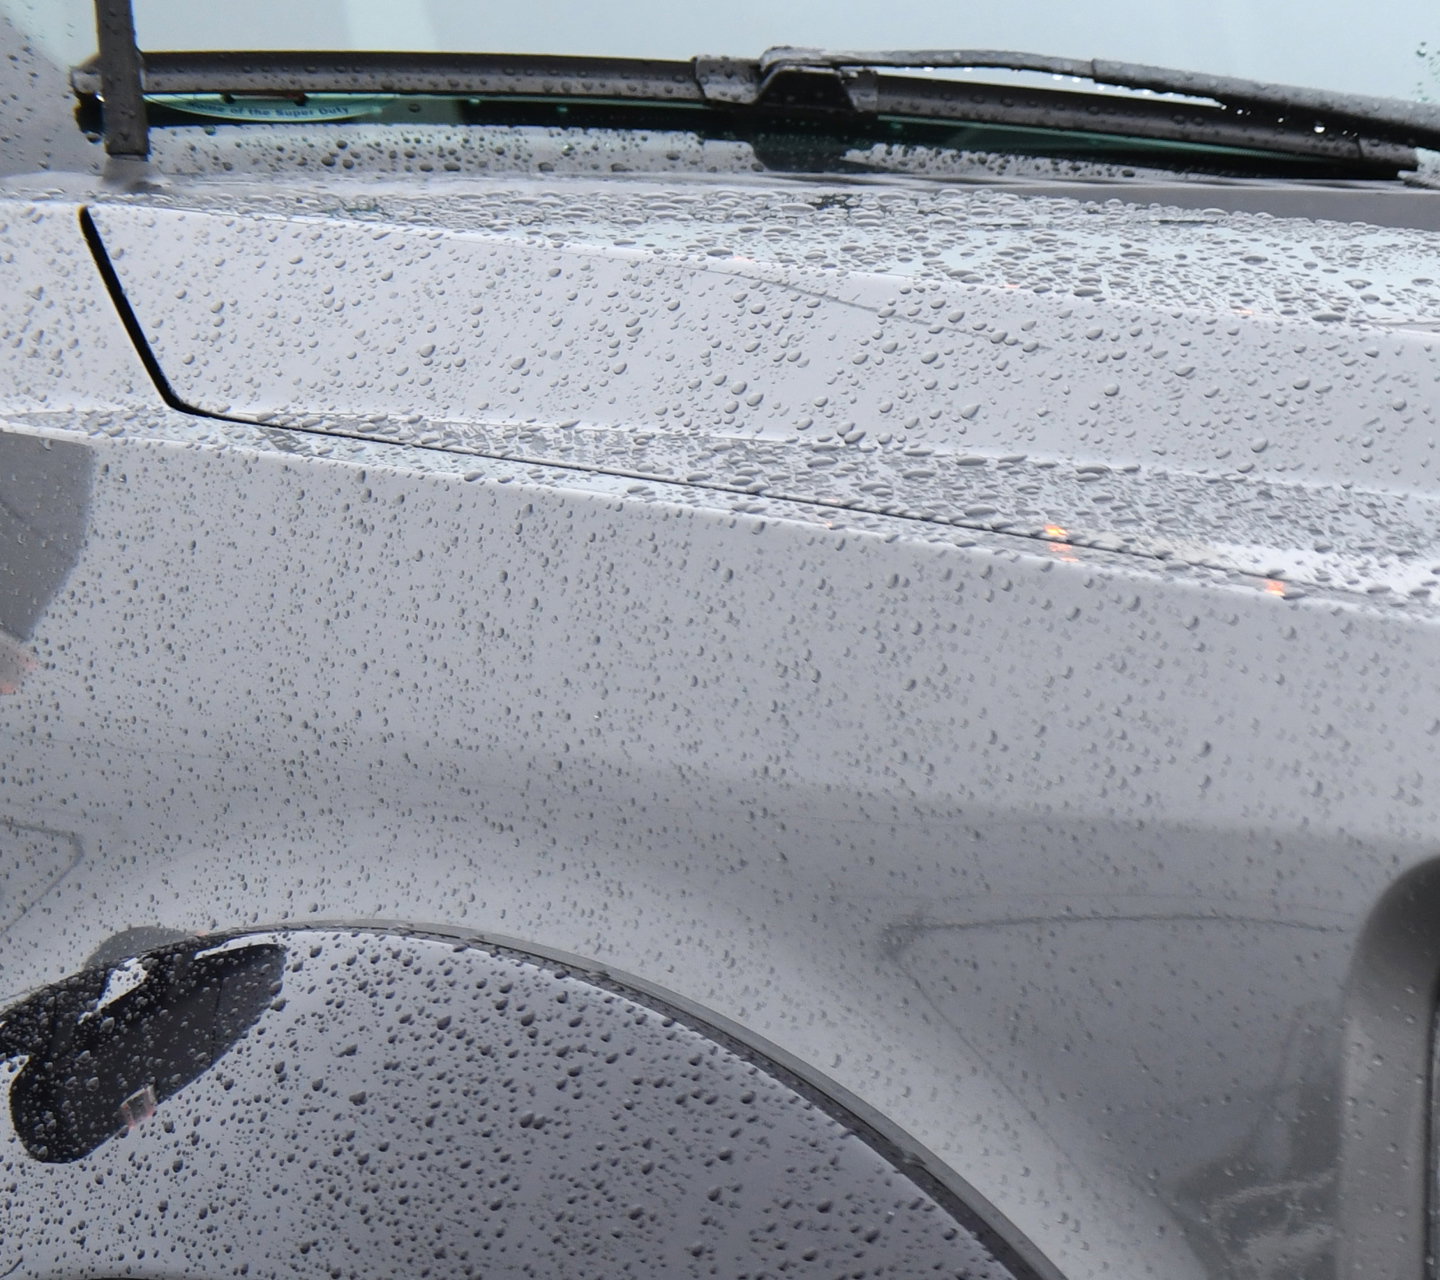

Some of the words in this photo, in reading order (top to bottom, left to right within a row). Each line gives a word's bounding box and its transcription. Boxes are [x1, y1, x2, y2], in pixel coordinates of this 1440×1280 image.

[249, 105, 270, 117] the
[275, 107, 314, 119] Super
[319, 105, 350, 116] Duty
